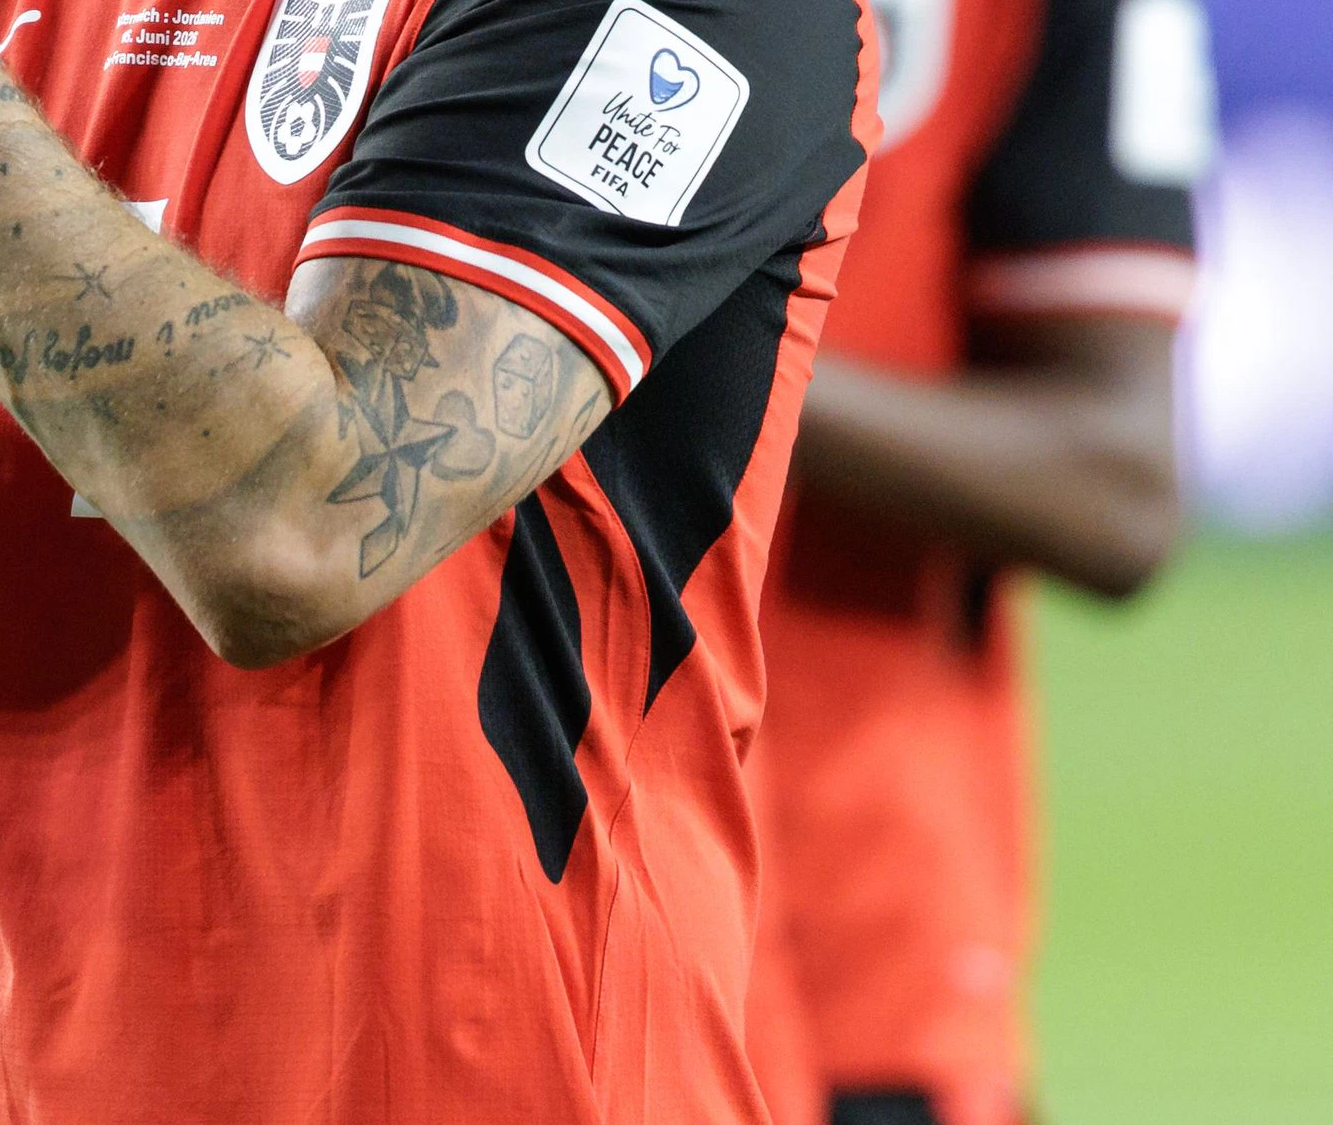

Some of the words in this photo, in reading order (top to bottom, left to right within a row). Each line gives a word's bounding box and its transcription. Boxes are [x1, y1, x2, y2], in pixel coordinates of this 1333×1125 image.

[135, 29, 170, 46] Juni
[172, 30, 200, 46] 2026
[602, 90, 657, 137] Unite
[652, 124, 682, 156] For
[588, 122, 664, 189] PEACE
[590, 163, 630, 197] FIFA
